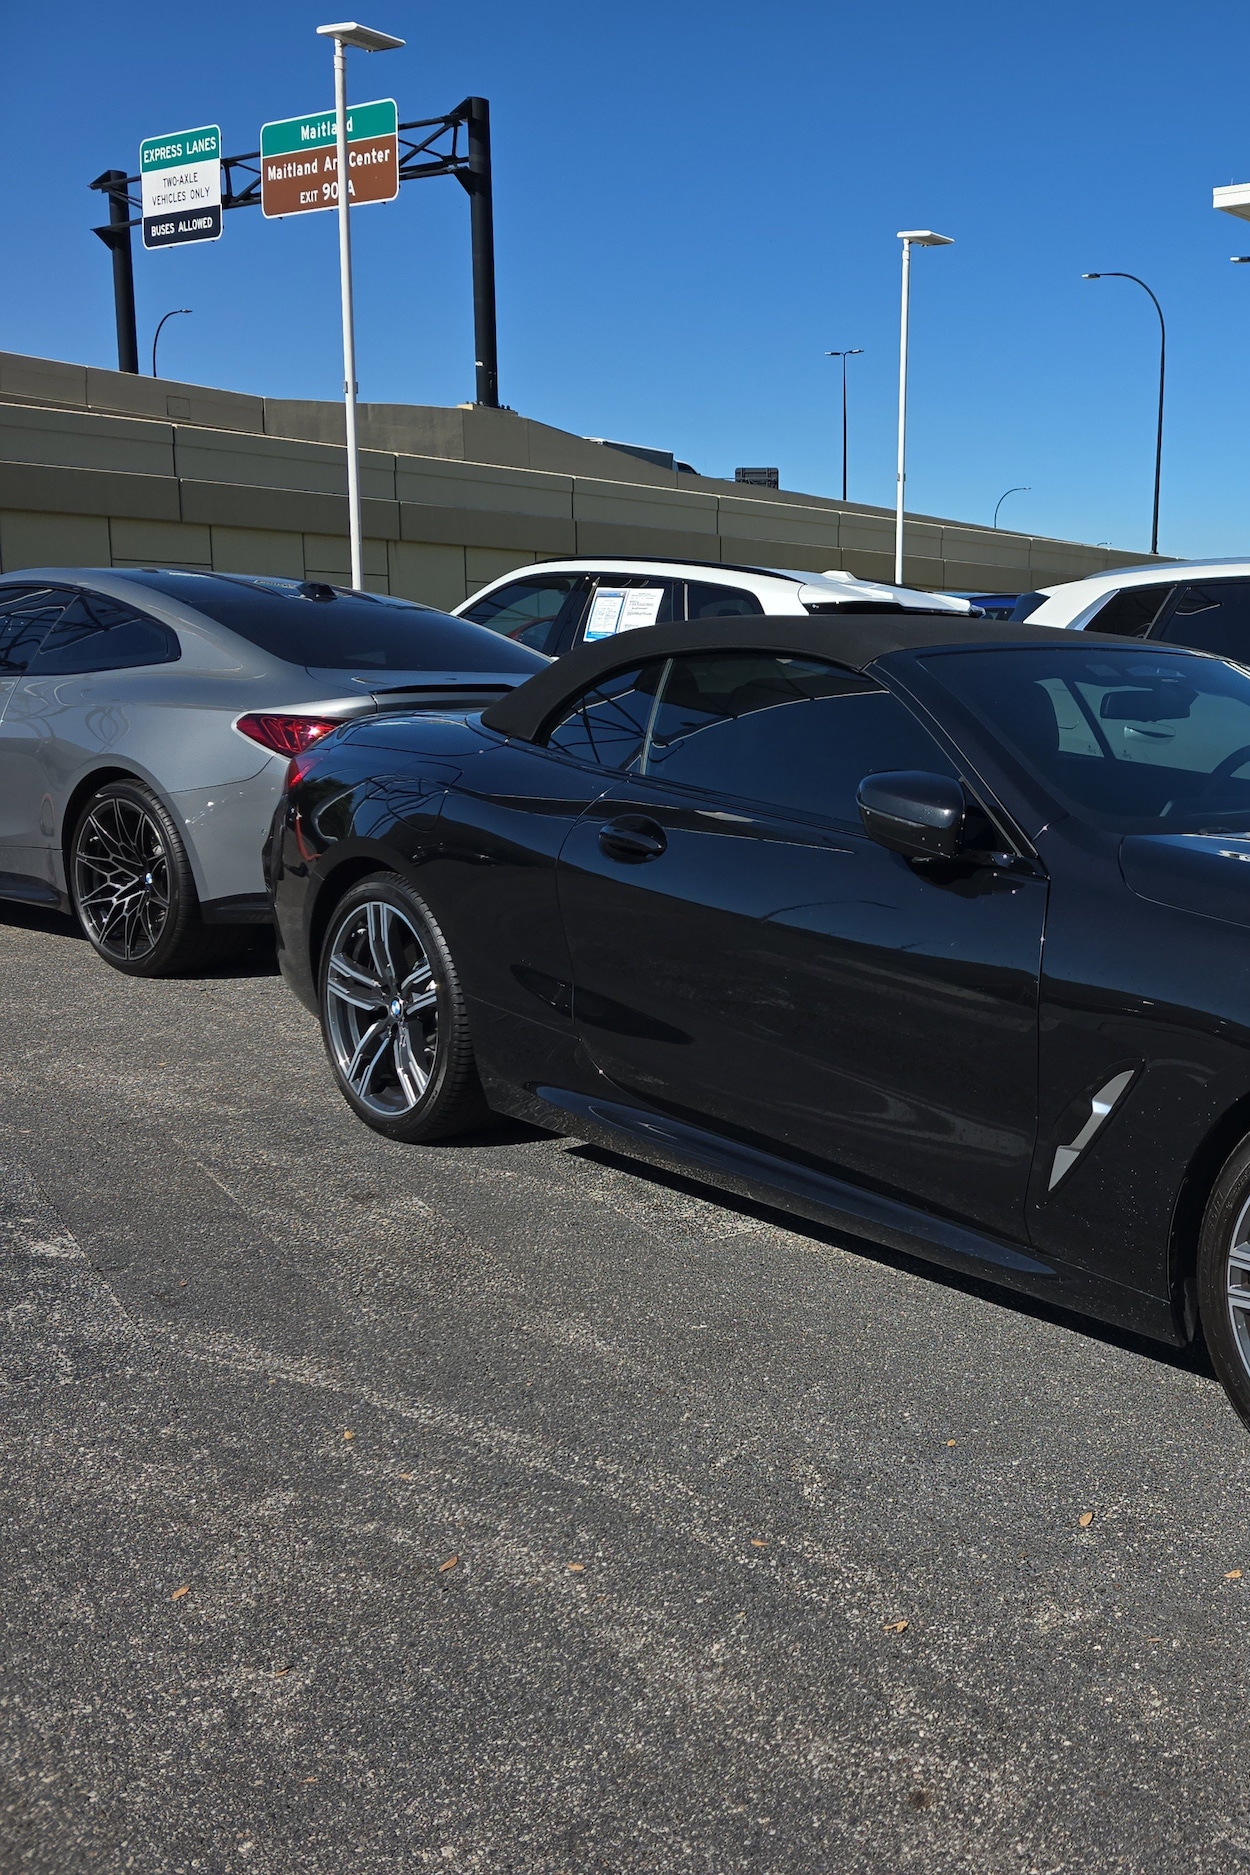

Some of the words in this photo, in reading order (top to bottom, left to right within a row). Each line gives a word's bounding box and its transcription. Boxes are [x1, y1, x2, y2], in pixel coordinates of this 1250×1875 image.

[301, 116, 353, 141] Maitlad
[143, 143, 183, 164] EXPRESS
[186, 136, 217, 155] LANES
[267, 158, 318, 181] Maitland
[324, 155, 340, 172] Ar
[348, 148, 390, 167] Center
[163, 172, 199, 188] TWO-AXLE
[152, 190, 187, 206] VEHICLES
[190, 186, 211, 200] ONLY
[300, 189, 318, 204] EXIT
[151, 222, 175, 237] BUSES
[178, 216, 213, 233] ALLOWED
